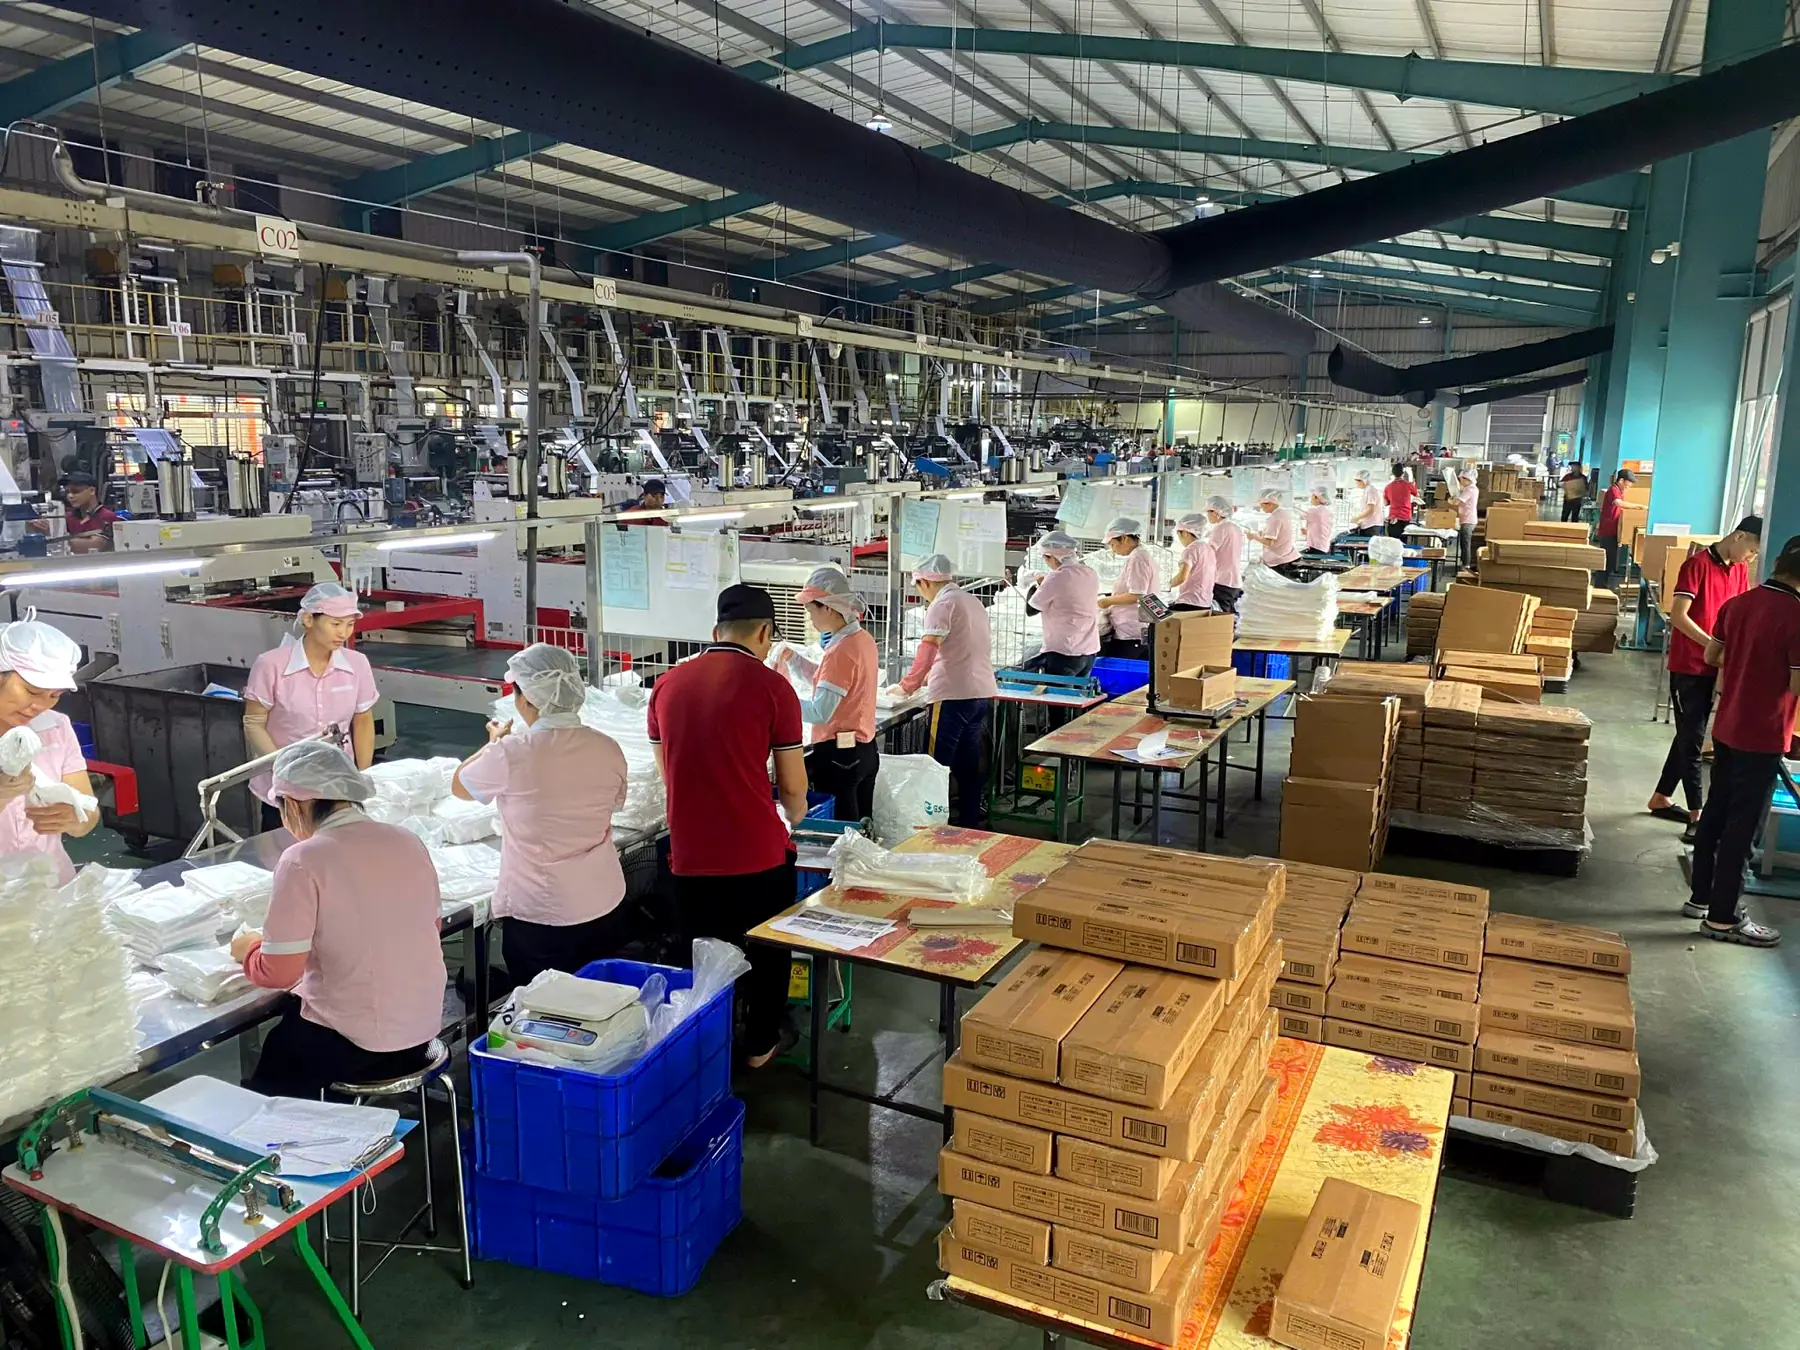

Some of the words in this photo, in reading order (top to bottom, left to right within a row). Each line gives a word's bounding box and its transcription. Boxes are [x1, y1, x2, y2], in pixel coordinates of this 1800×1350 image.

[260, 226, 299, 251] C02
[595, 283, 616, 301] C03
[37, 312, 57, 323] T05
[172, 324, 190, 334] T06
